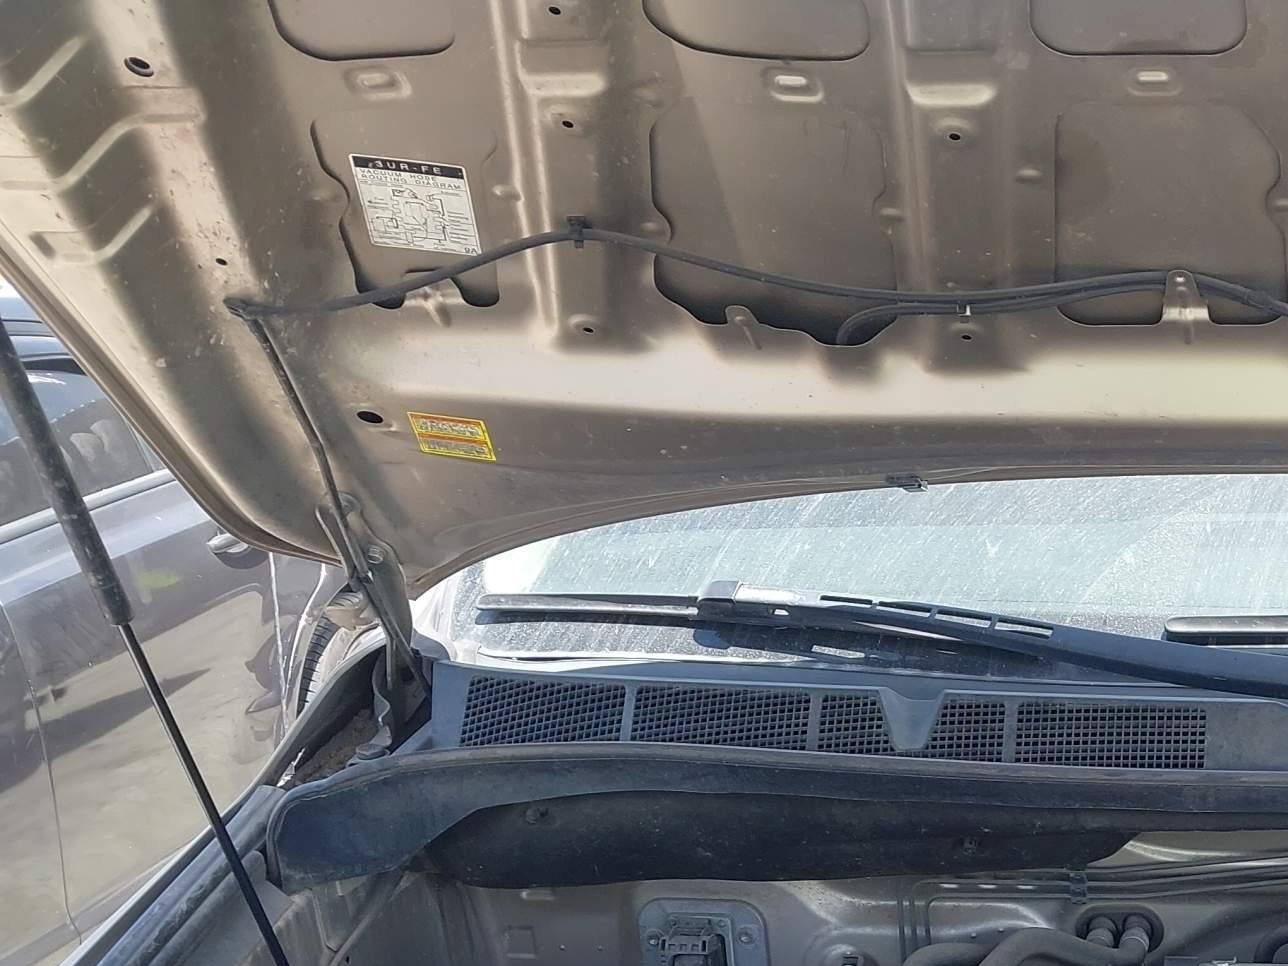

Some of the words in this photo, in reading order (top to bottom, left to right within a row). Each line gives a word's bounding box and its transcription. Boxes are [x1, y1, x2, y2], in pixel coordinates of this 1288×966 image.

[360, 169, 402, 178] VACUUM
[409, 174, 437, 182] HOSE
[361, 174, 409, 184] ROUTING
[415, 179, 462, 190] DIAGRAM
